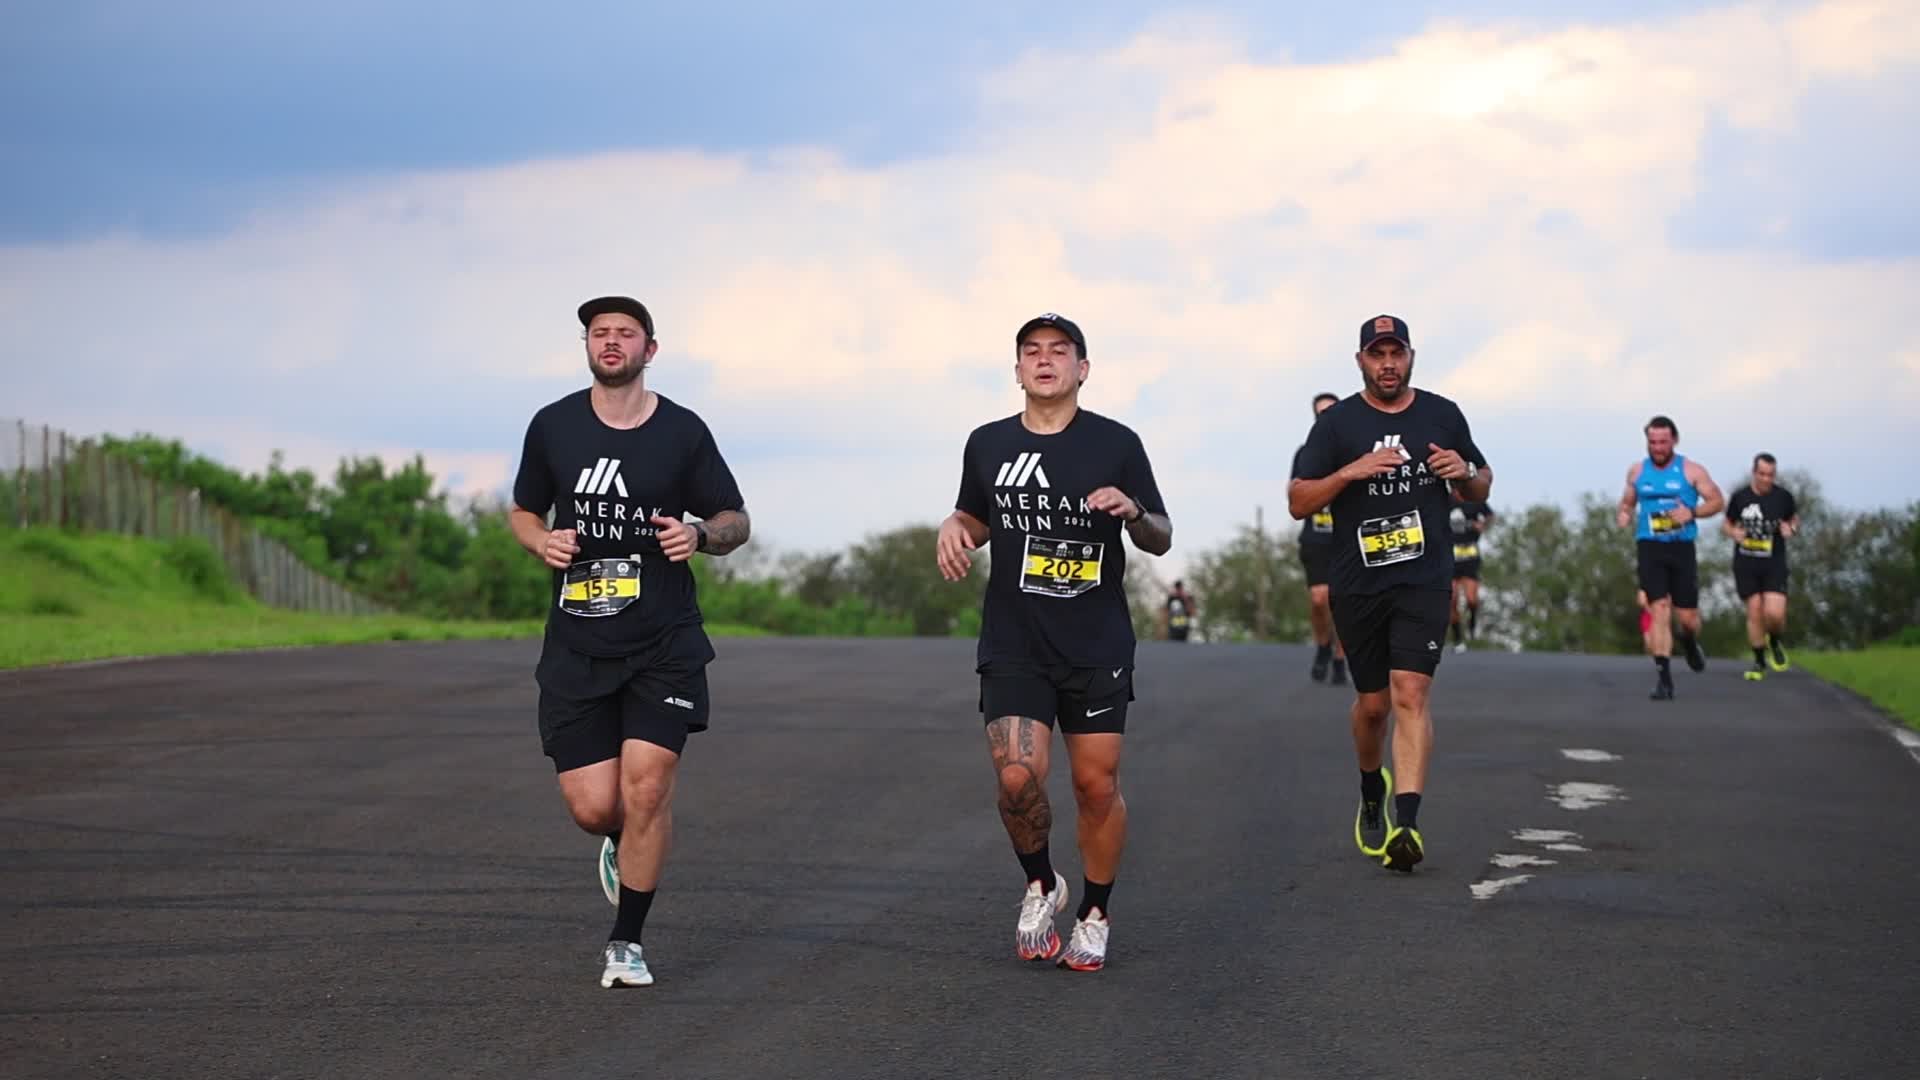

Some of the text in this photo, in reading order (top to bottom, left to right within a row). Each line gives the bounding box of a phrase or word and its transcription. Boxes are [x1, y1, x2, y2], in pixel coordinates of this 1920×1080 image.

[1368, 481, 1411, 496] RUN
[574, 499, 662, 522] MERAK
[995, 493, 1091, 514] MERAK
[576, 519, 623, 541] RUN
[1001, 513, 1092, 532] RUN 2026
[1375, 530, 1408, 551] 358
[1042, 558, 1084, 578] 202
[584, 579, 618, 599] 155
